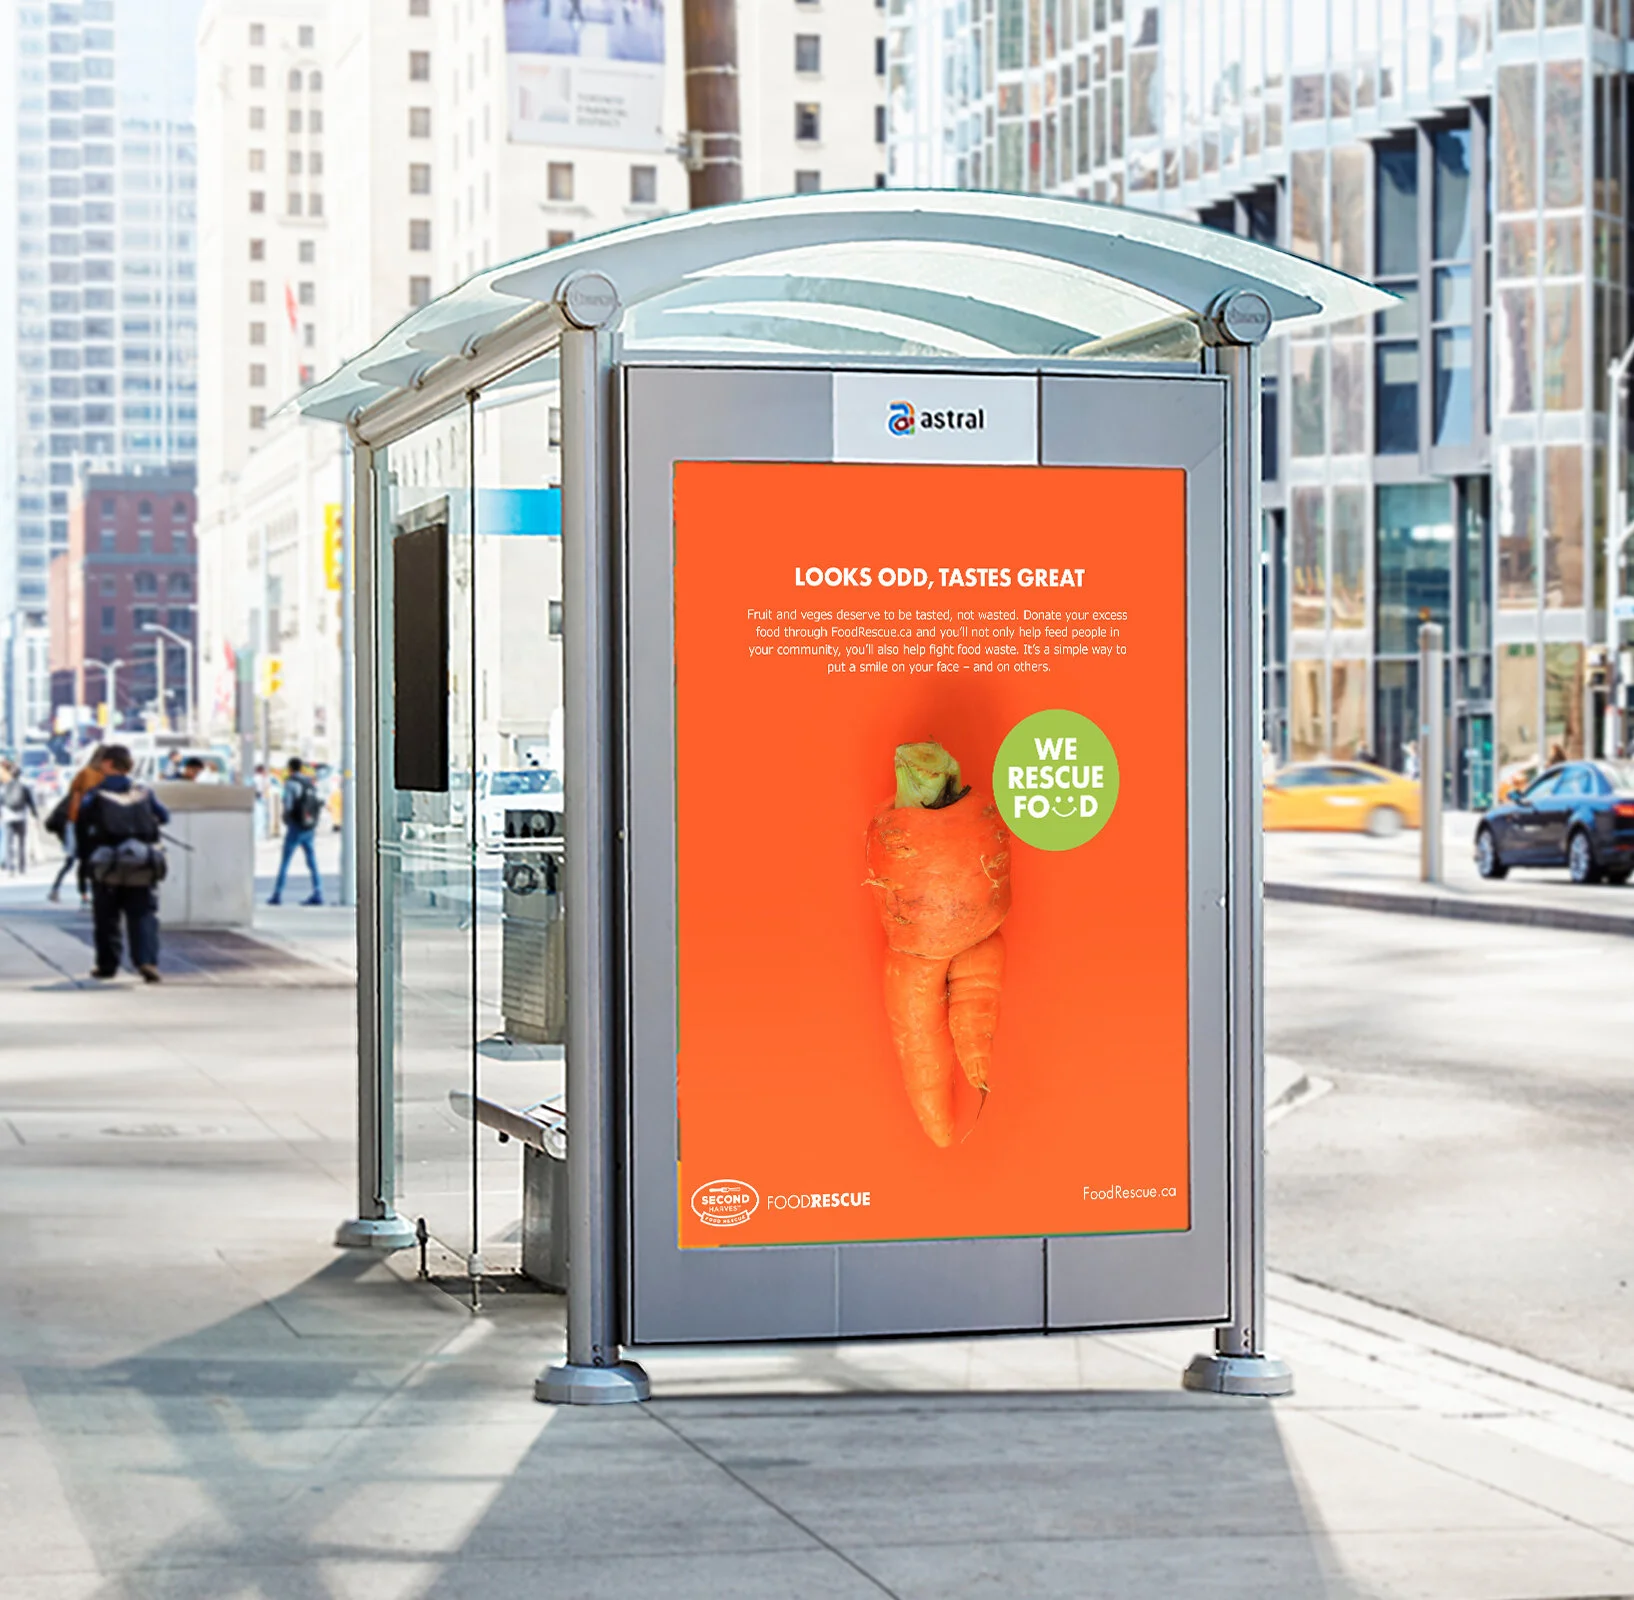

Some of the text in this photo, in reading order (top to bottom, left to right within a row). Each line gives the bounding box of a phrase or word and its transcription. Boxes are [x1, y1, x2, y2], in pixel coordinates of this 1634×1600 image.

[921, 408, 984, 429] astral
[795, 567, 1085, 590] LOOKS ODD, TASTES GREAT
[748, 609, 1127, 622] Fruit and veges deserve to be tasted, not wasted. Donate your excess
[756, 626, 780, 637] food
[784, 626, 828, 639] through
[832, 626, 912, 637] FoodRescue.ca
[916, 626, 935, 637] and
[972, 627, 989, 637] not
[993, 626, 1014, 639] only
[1019, 627, 1041, 639] help
[1045, 626, 1067, 637] feed
[1072, 626, 1106, 639] people
[1110, 627, 1119, 637] in
[749, 646, 774, 657] your
[777, 644, 840, 657] community,
[878, 644, 898, 655] also
[904, 644, 926, 657] help
[929, 644, 954, 657] fight
[958, 644, 980, 655] food
[985, 644, 1018, 655] waste.
[1044, 646, 1050, 655] a
[1054, 644, 1088, 656] simple
[1092, 646, 1112, 656] way
[1116, 644, 1126, 654] to
[828, 662, 846, 674] put
[849, 663, 856, 672] a
[860, 661, 888, 672] smile
[892, 663, 905, 672] on
[909, 663, 933, 674] your
[937, 661, 959, 672] face
[974, 661, 993, 672] and
[997, 663, 1009, 672] on
[1014, 661, 1050, 672] others.
[1034, 738, 1077, 760] WE
[1008, 766, 1104, 789] RESCUE
[1083, 1184, 1177, 1200] FoodRescue.ca
[701, 1194, 750, 1205] SECOND
